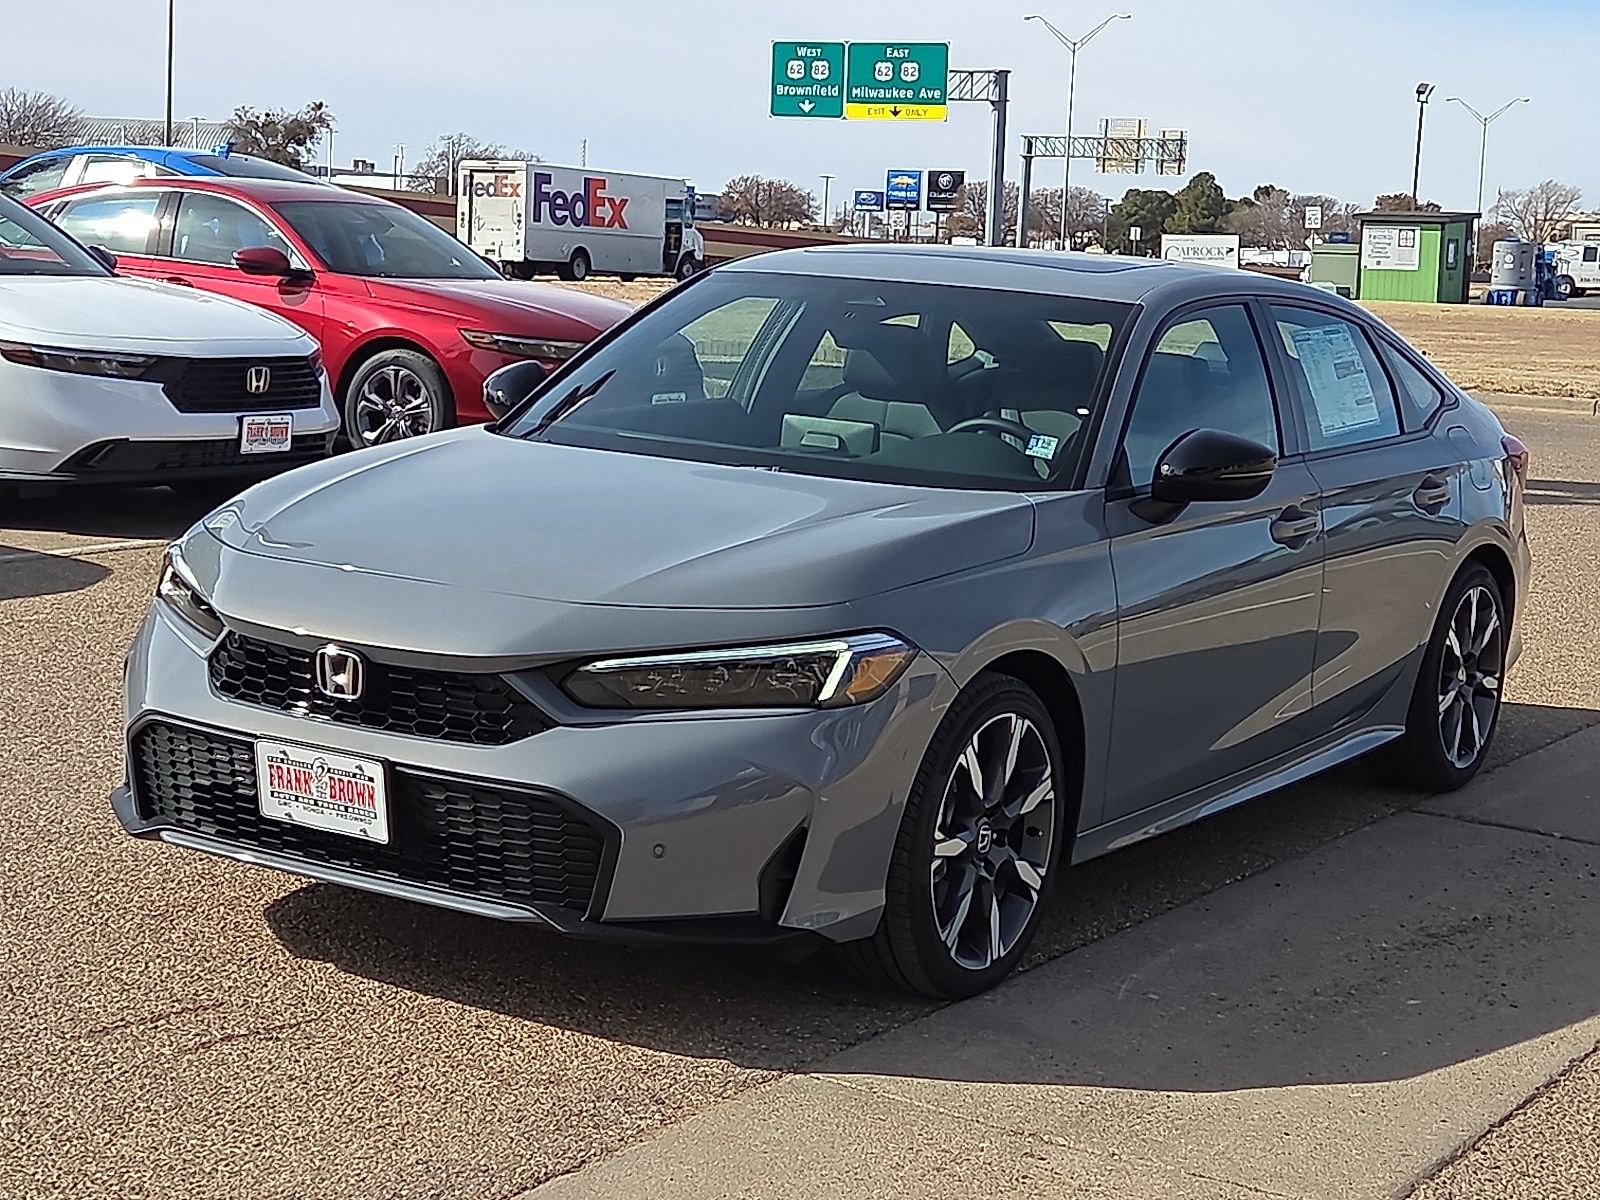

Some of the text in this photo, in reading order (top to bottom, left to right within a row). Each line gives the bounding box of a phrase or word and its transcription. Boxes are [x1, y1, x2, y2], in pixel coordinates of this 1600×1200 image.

[796, 46, 822, 57] WEST
[886, 47, 910, 58] EAST
[789, 63, 828, 76] 62 82
[877, 65, 917, 77] 62 82
[776, 84, 839, 97] Brownfield
[851, 86, 942, 99] Milwaukee Ave
[867, 107, 929, 117] EXIT ONLY
[462, 173, 522, 198] FedEx
[532, 172, 629, 229] FedEx
[1164, 245, 1225, 260] CAPROCK
[267, 764, 377, 811] FRANK BROWN
